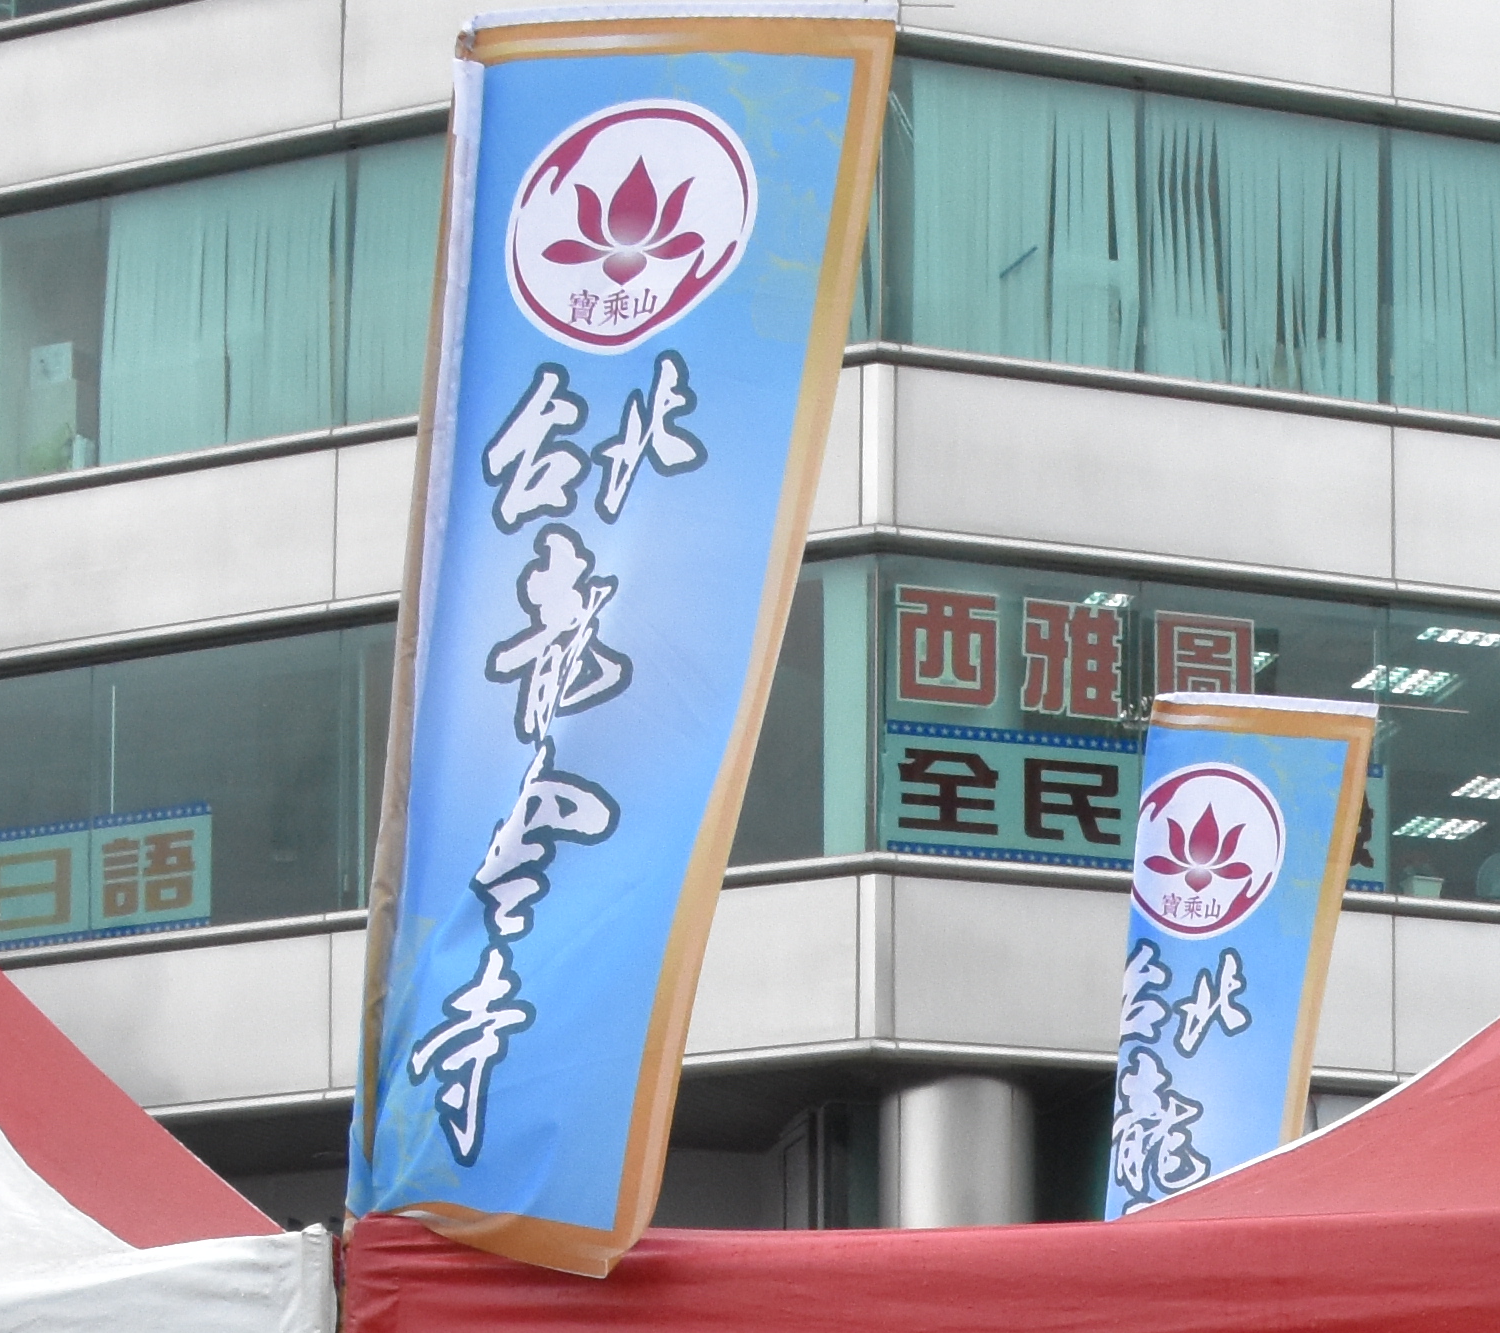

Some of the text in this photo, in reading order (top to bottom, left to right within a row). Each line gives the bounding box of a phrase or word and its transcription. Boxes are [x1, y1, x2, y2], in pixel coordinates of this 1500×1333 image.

[569, 289, 657, 326] 寶乘山
[896, 583, 1255, 719] 西雅圖
[1161, 894, 1222, 922] 寶乘山
